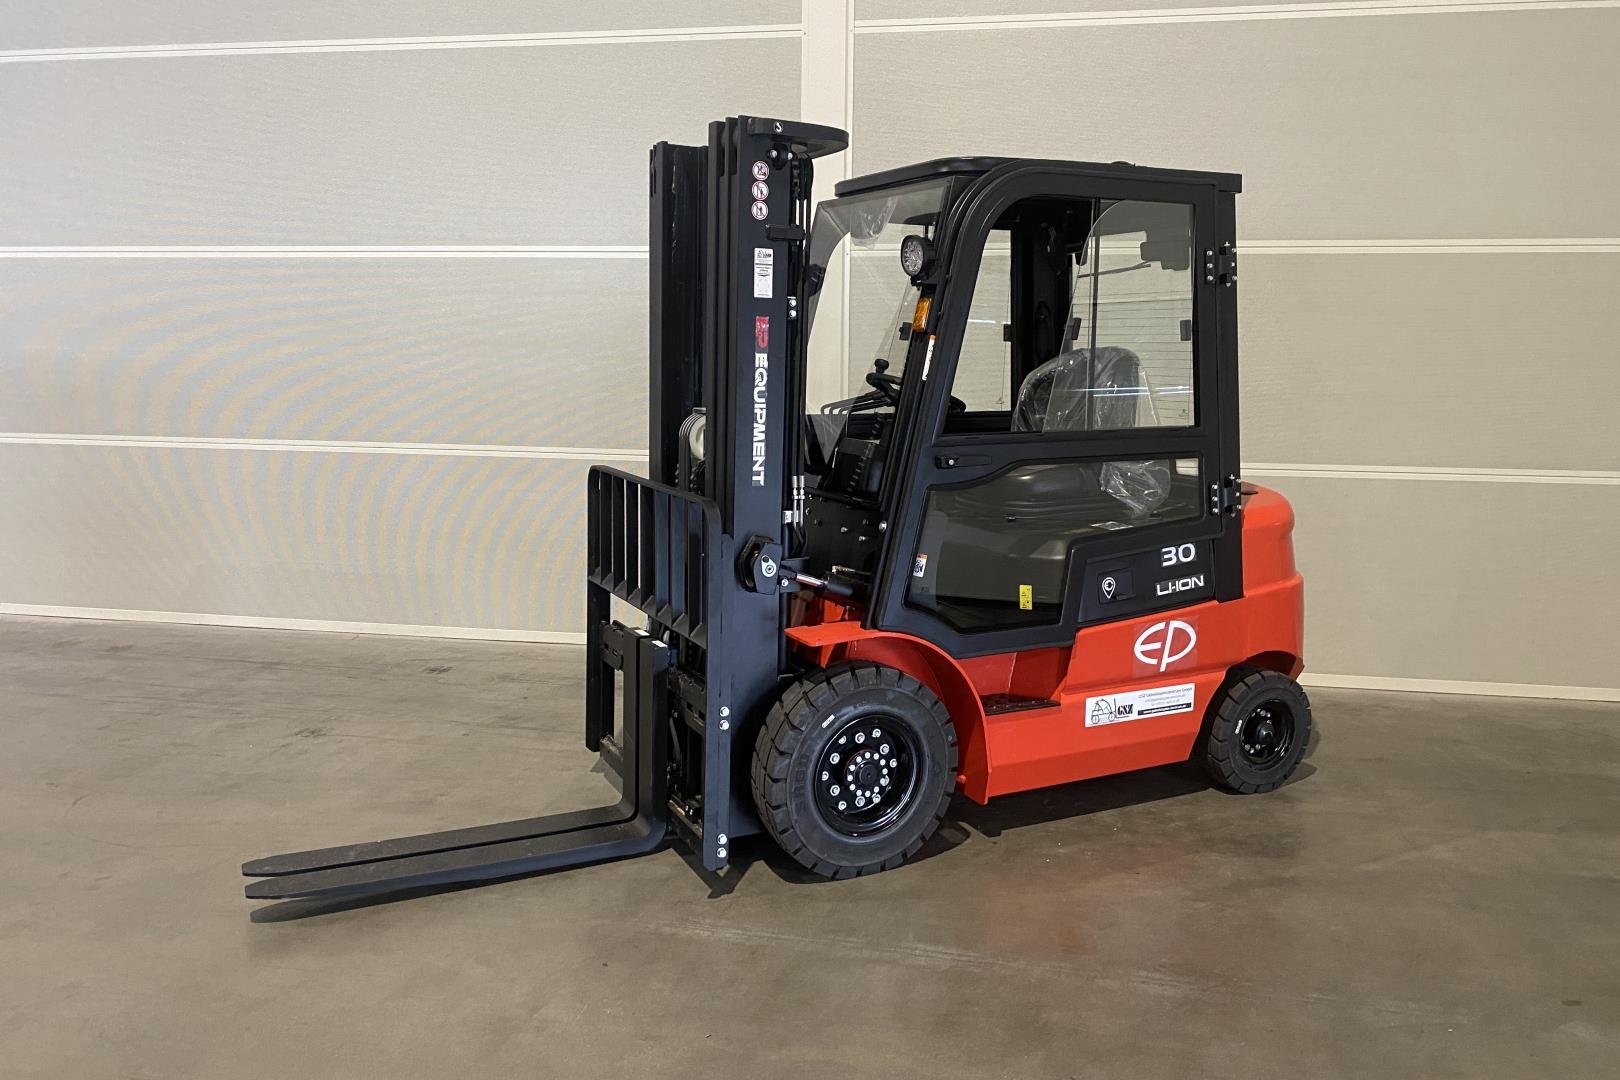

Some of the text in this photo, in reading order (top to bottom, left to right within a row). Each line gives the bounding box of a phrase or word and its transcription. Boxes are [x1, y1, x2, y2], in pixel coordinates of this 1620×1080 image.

[751, 352, 768, 486] EQUIPMENT
[1161, 543, 1196, 567] 30
[1156, 575, 1204, 596] LI-ION
[1134, 620, 1197, 672] EP
[1117, 703, 1134, 716] GSZ
